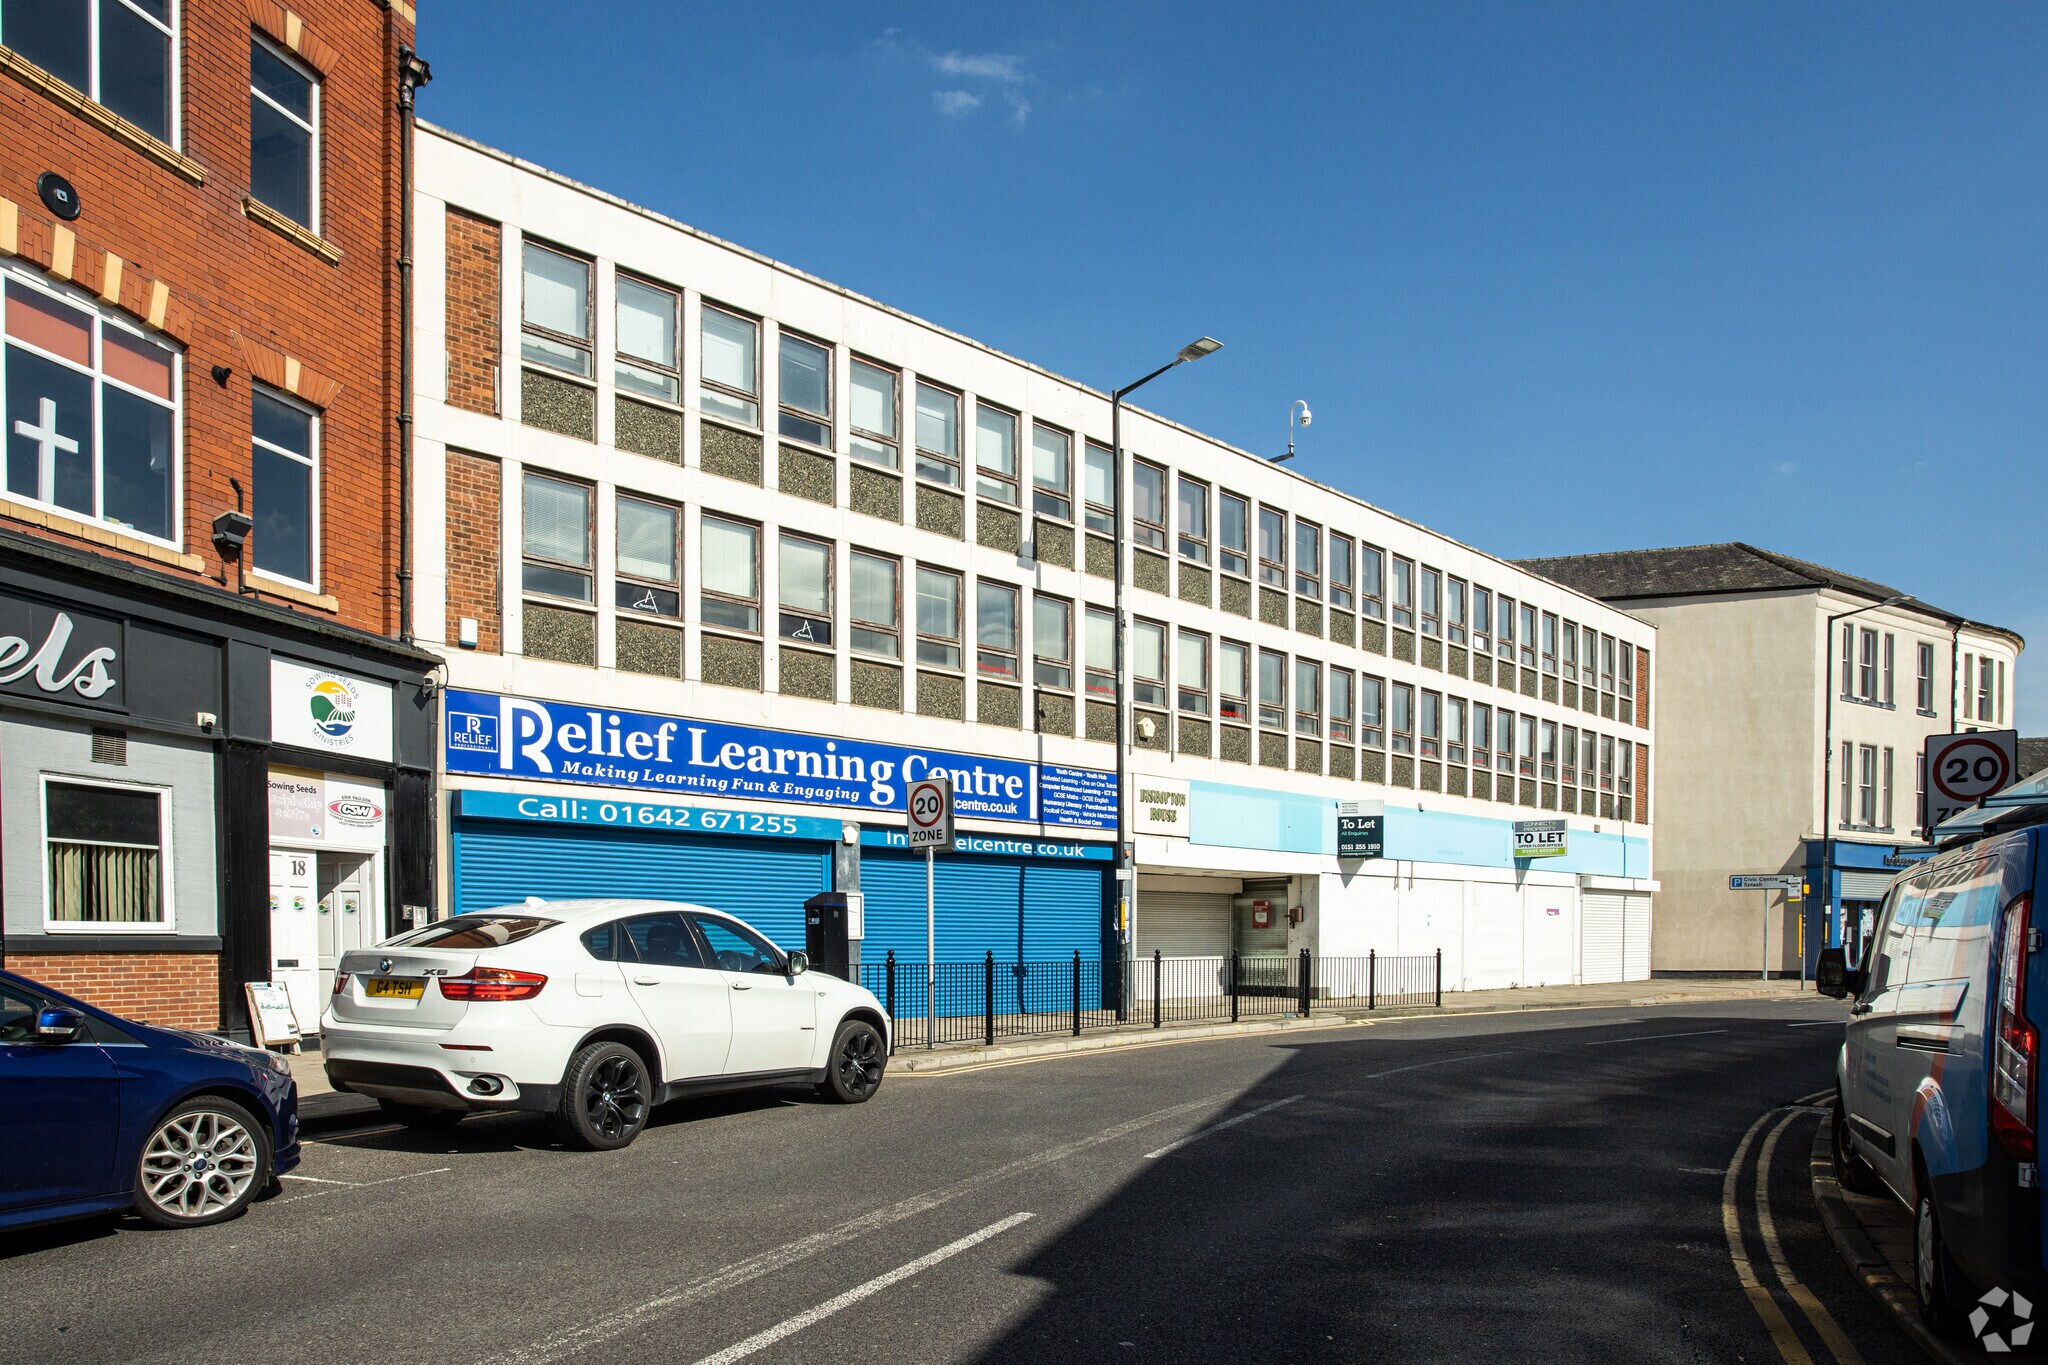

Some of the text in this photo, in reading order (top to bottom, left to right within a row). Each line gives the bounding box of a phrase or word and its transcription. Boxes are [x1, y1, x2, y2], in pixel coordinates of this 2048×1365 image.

[305, 670, 360, 700] SOWING SEEDS
[311, 727, 354, 747] MINISTRIES
[454, 731, 492, 745] RELIEF
[500, 695, 1024, 806] Relief Learning Centre
[1946, 756, 1998, 783] 20
[268, 780, 317, 794] Sowing Seeds
[561, 760, 860, 803] Making Learning Fun & Engaging
[915, 796, 939, 815] 20
[1140, 789, 1186, 806] BISHOPTON
[341, 803, 371, 817] CSW
[518, 798, 797, 834] Call: 01642 671255
[1150, 807, 1177, 823] HOUSE
[1341, 818, 1375, 829] To Let
[912, 829, 943, 842] ZONE
[1515, 832, 1565, 843] TO LET
[291, 860, 306, 876] 18
[422, 968, 449, 976] X6
[376, 981, 413, 995] G4 TSH
